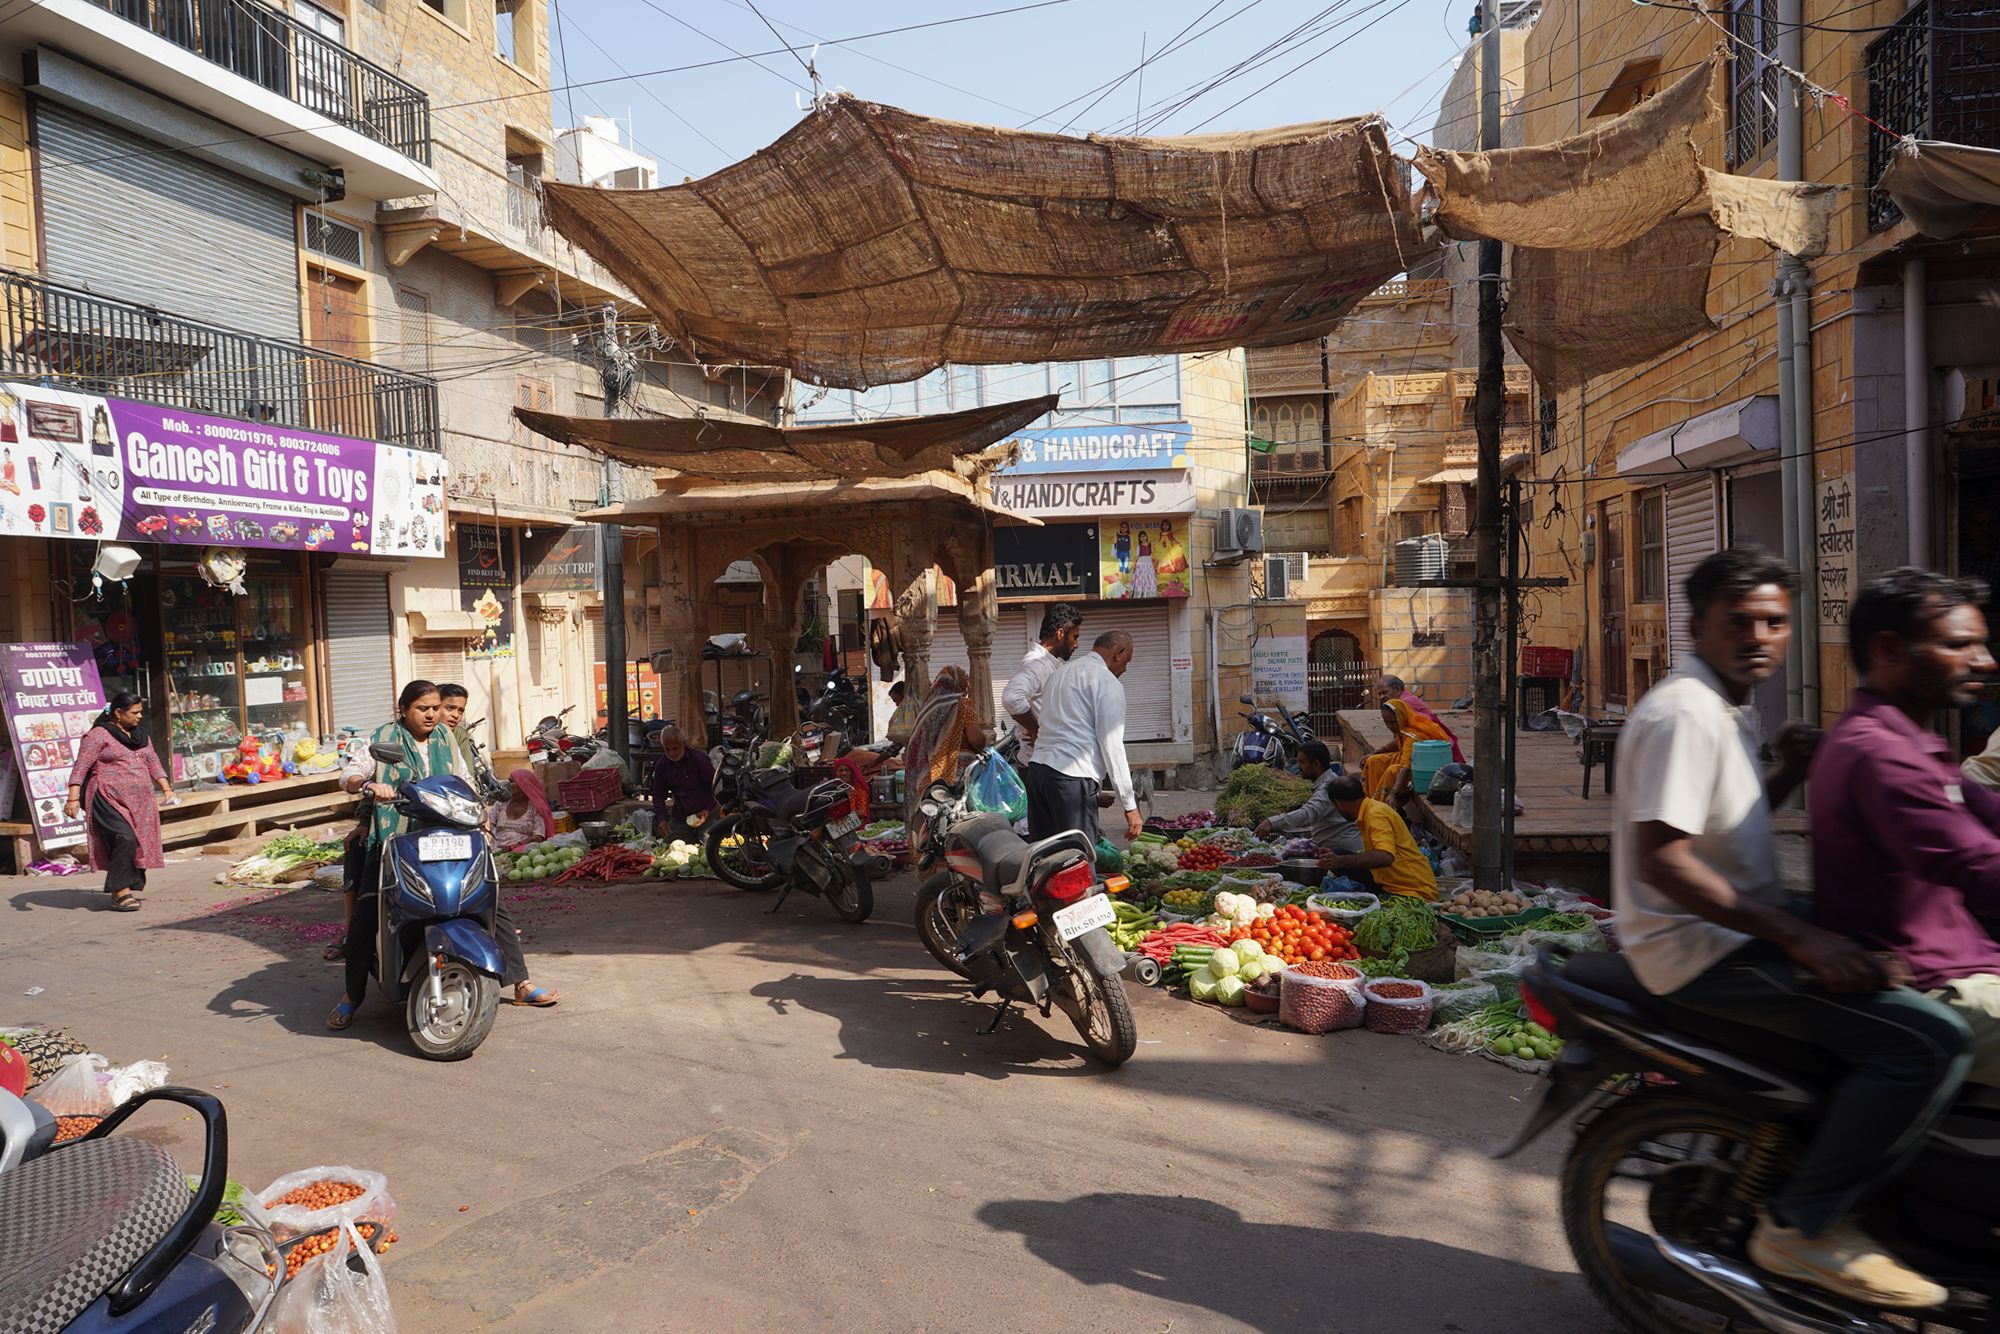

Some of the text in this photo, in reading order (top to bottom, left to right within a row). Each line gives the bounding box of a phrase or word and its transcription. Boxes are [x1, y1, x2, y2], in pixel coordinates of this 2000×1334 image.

[162, 418, 193, 434] Mob.
[204, 424, 278, 448] 8000201976,
[280, 435, 341, 456] 8003724006
[1021, 433, 1176, 463] & HANDICRAFT
[127, 431, 367, 503] Ganesh Gift & Toys
[140, 489, 151, 500] All
[152, 491, 171, 503] Type
[173, 493, 181, 502] of
[262, 500, 282, 511] Frame
[290, 502, 303, 512] Kids
[318, 506, 345, 517] Available
[1001, 490, 1012, 510] &
[1013, 479, 1157, 509] HANDICRAFTS
[1821, 481, 1851, 522] श्रीजी
[1130, 521, 1161, 529] KIDS WEAR
[467, 568, 481, 577] FIND
[481, 568, 494, 577] BEST
[522, 561, 595, 576] FIND BEST TRIP
[18, 660, 84, 688] गणेश
[16, 688, 98, 709] गिफ्ट एण्ड टॉय
[54, 824, 84, 835] Home
